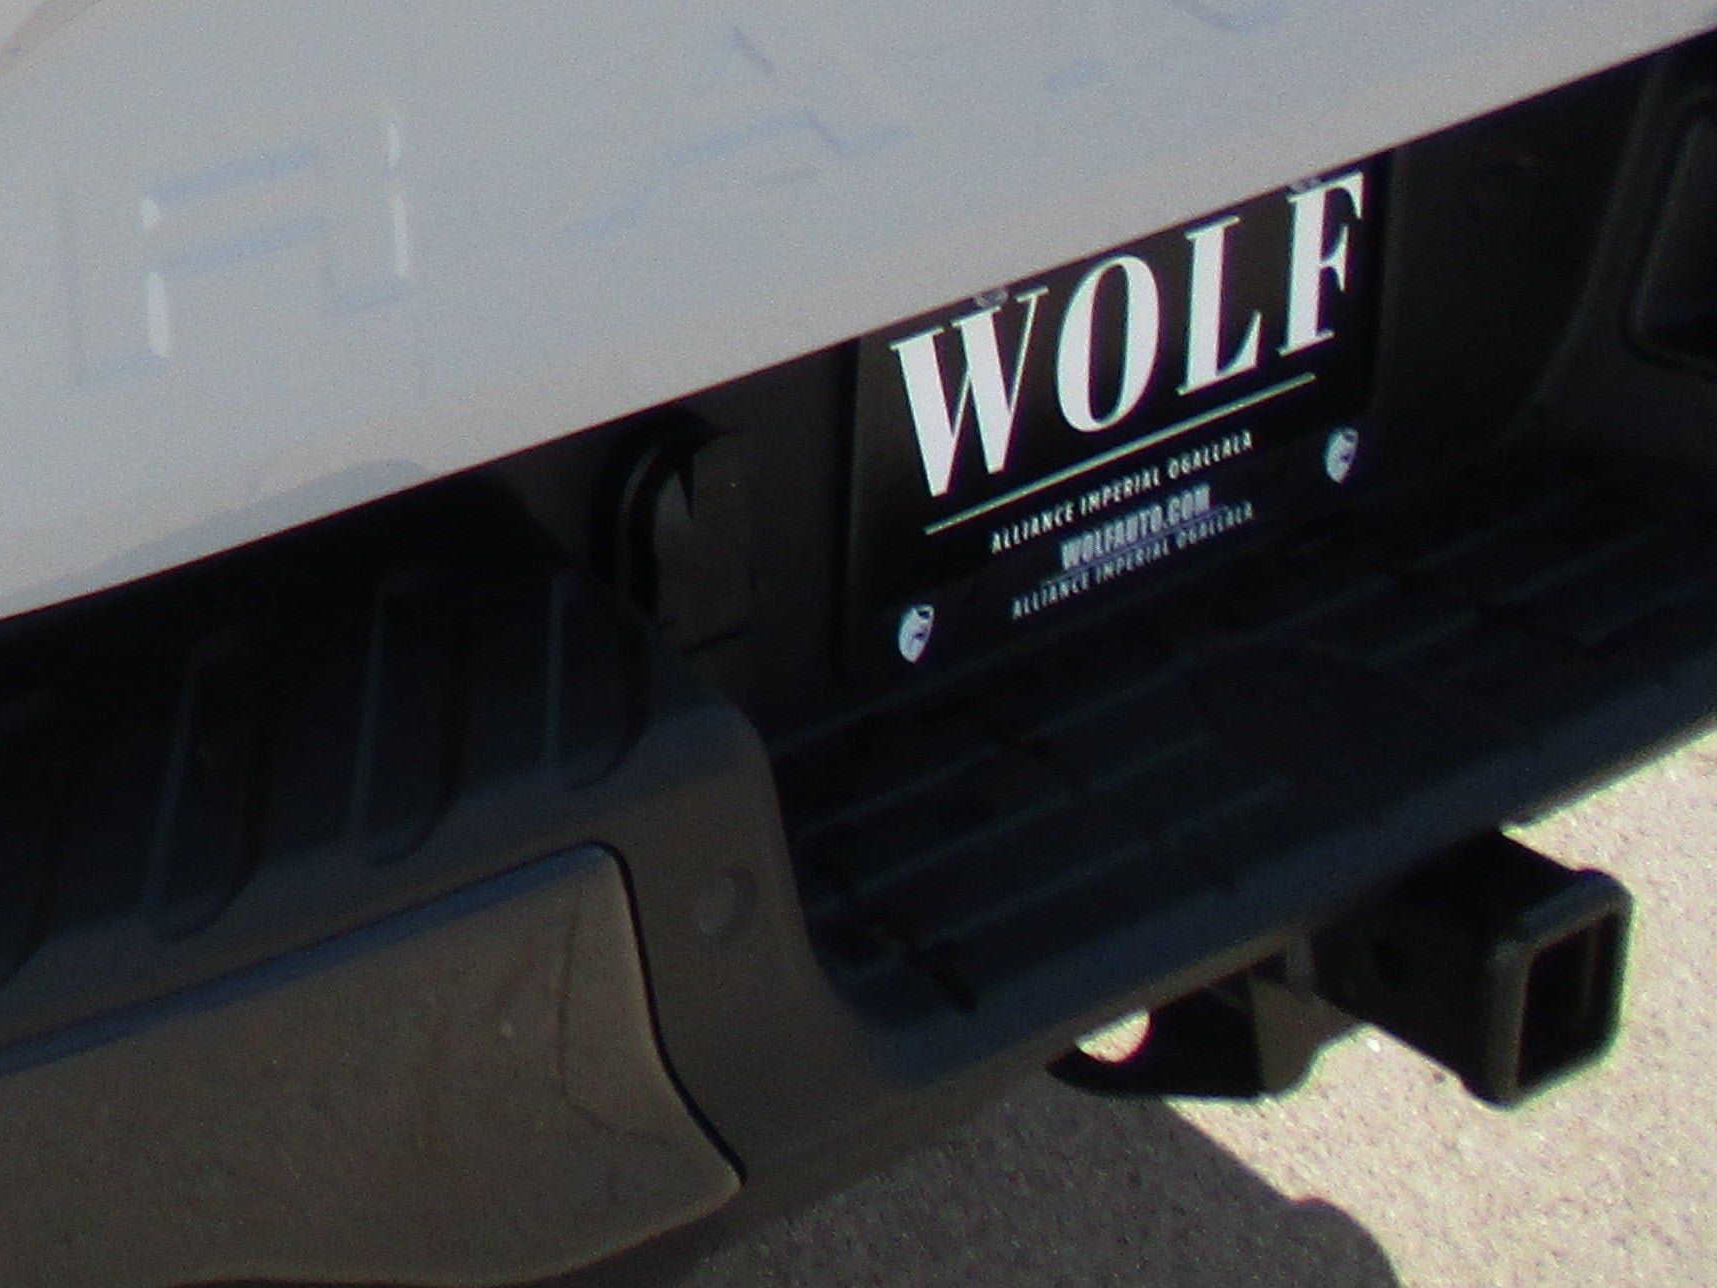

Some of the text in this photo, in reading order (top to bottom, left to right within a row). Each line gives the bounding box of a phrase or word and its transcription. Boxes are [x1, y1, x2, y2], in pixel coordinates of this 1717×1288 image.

[890, 171, 1366, 499] WOLF
[989, 429, 1253, 555] ALLIANCE IMPERIAL OGALLALA
[1060, 483, 1212, 569] WOLFAUTO.COM
